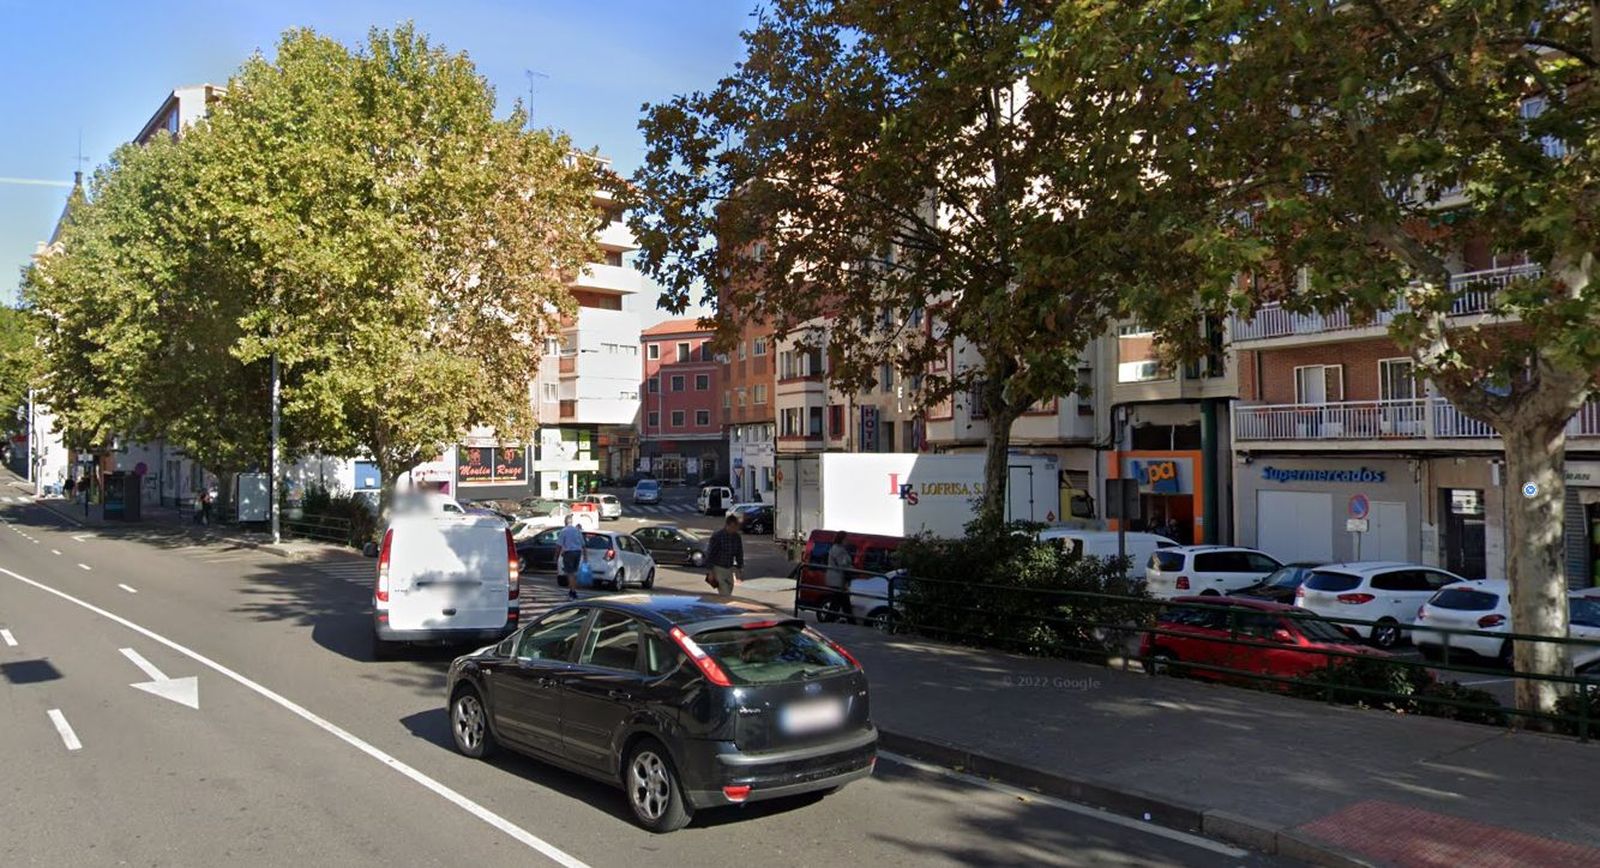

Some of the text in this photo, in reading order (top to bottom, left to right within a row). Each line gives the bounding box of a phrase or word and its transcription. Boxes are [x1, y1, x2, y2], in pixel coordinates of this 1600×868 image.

[865, 408, 875, 450] HOTE
[458, 464, 492, 476] Moulin
[496, 464, 523, 477] Rouge
[1262, 465, 1386, 482] Supermercados
[1562, 472, 1591, 481] RAN
